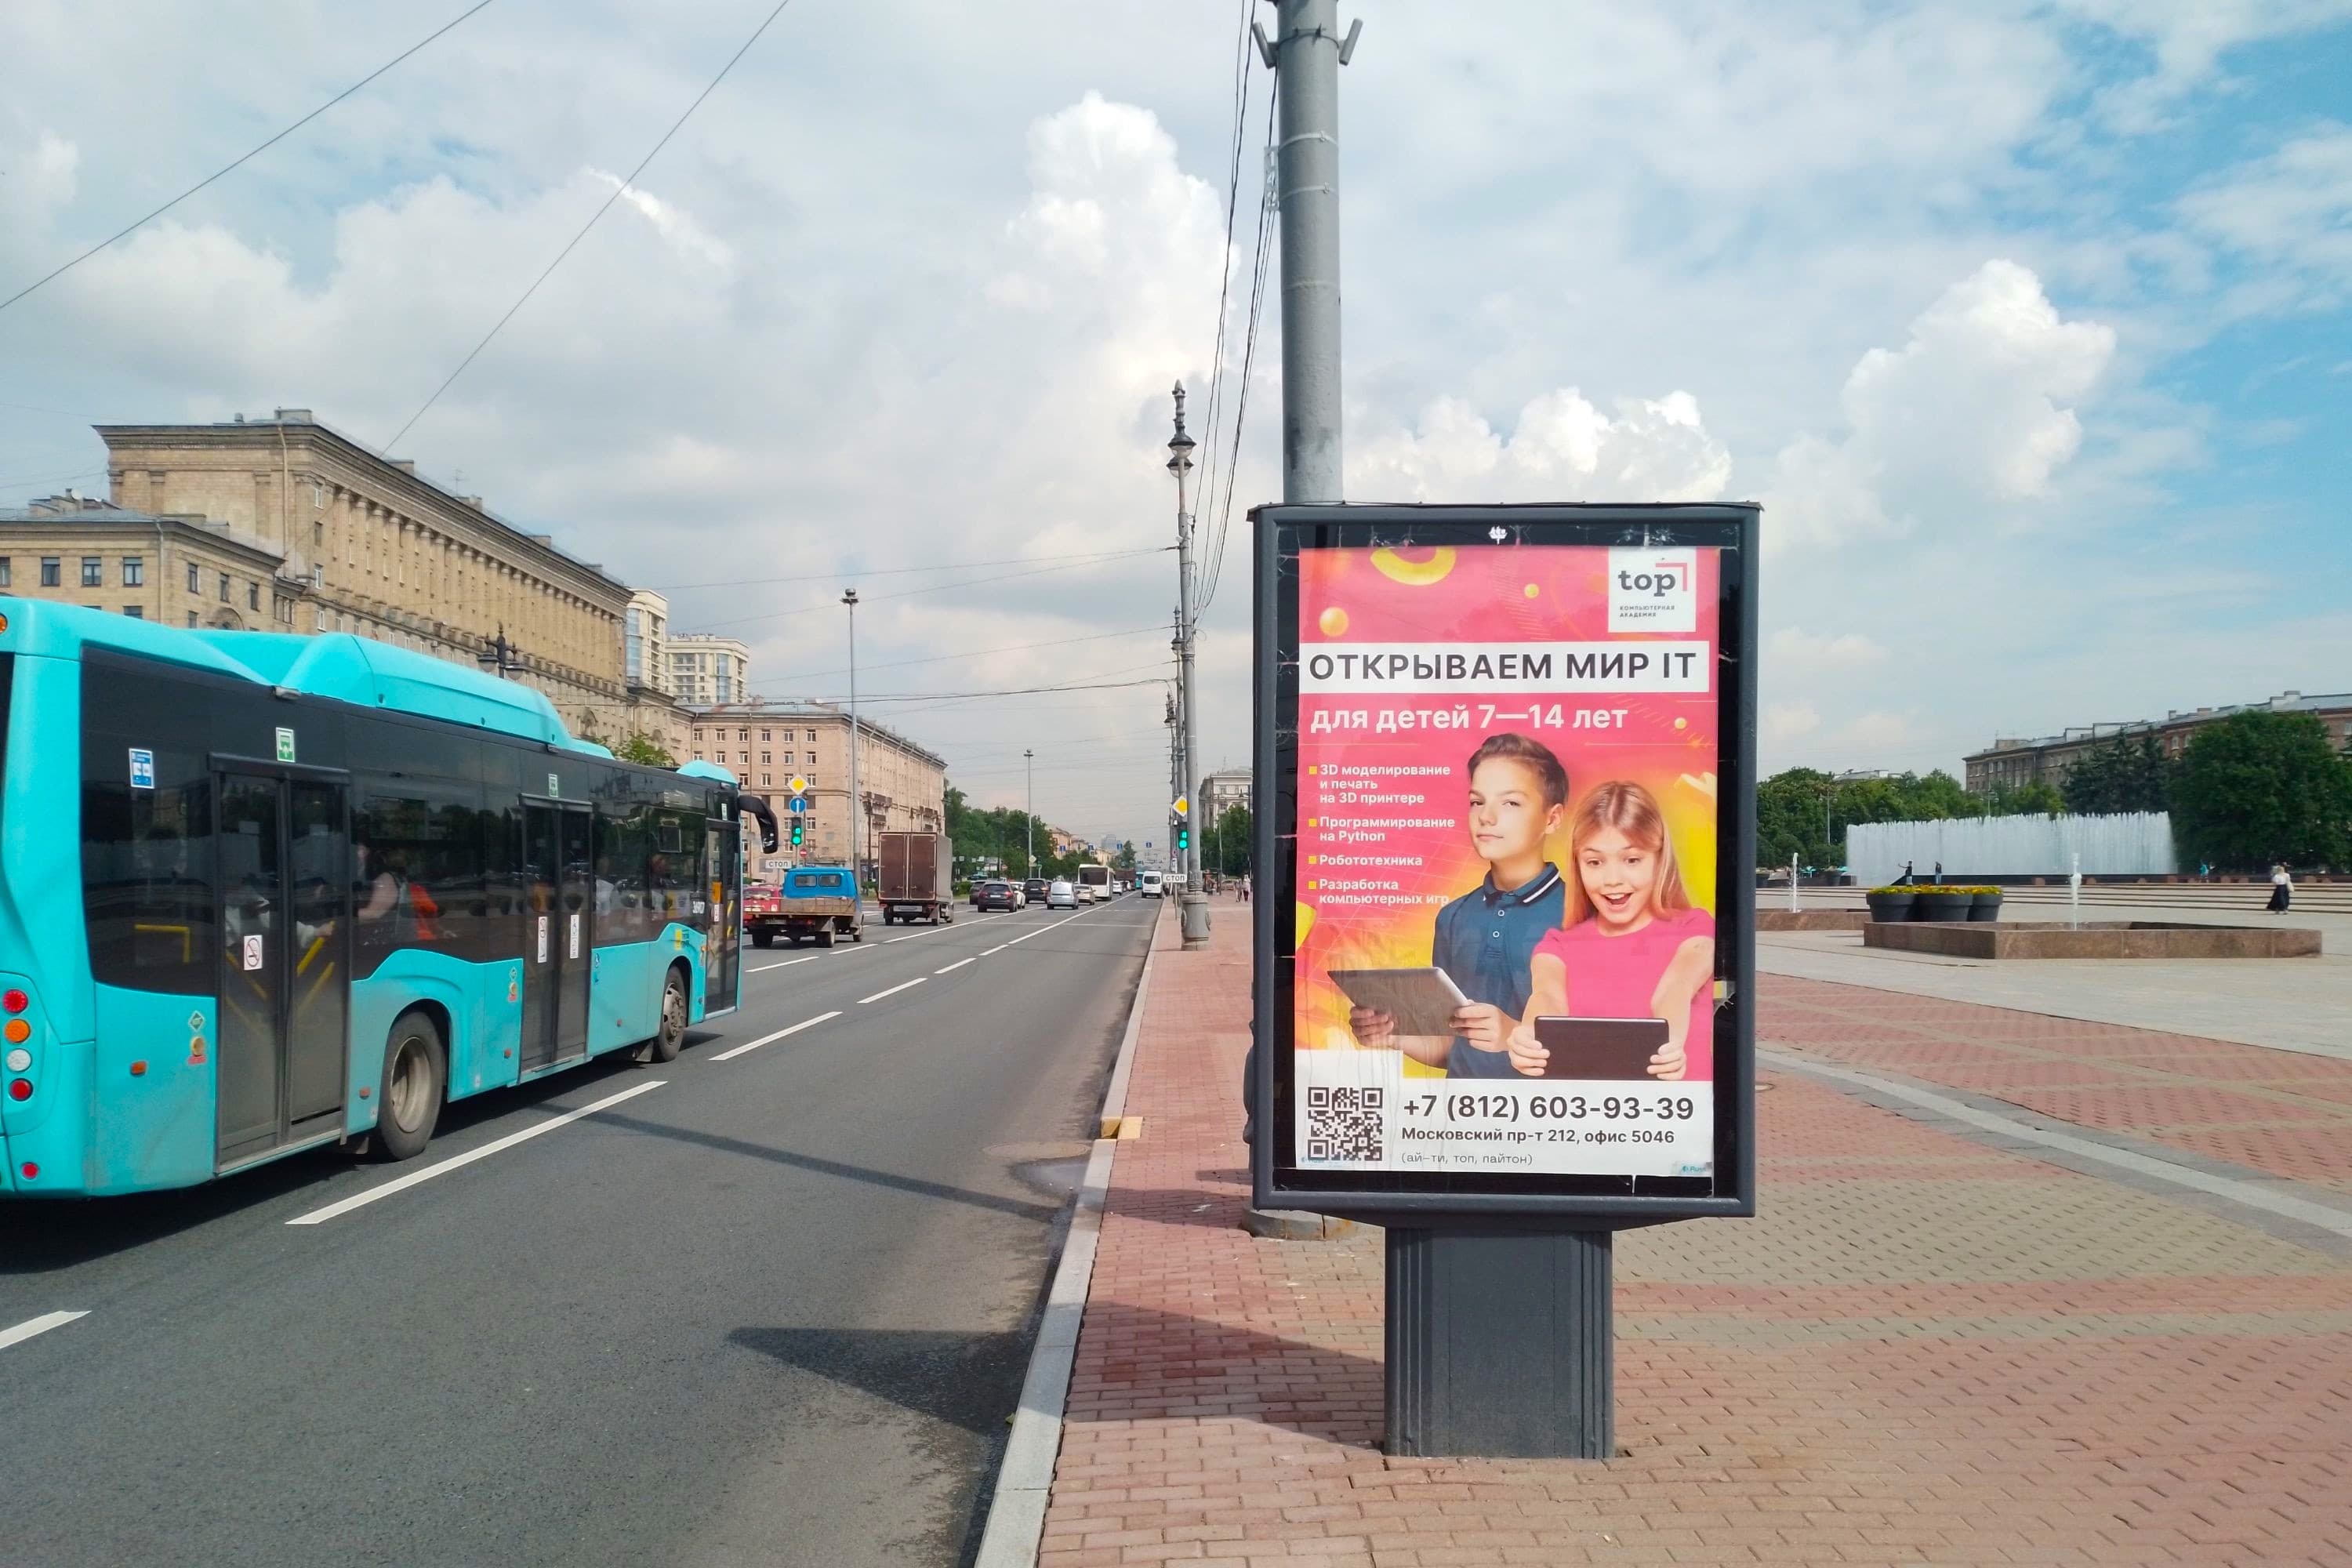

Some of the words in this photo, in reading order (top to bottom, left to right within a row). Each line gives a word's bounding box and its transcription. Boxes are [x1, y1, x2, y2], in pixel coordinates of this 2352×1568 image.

[1617, 570, 1676, 597] top
[1309, 654, 1552, 681] ОТКРЫВАЕМ
[1566, 653, 1650, 679] МИР
[1663, 652, 1697, 679] IT
[1310, 710, 1367, 734] для
[1375, 704, 1469, 734] детей
[1572, 709, 1628, 728] лет
[1320, 764, 1338, 775] 3D
[1341, 765, 1451, 777] моделирование
[1319, 780, 1328, 789] и
[1331, 780, 1378, 789] печать
[1319, 794, 1335, 804] на
[1338, 792, 1357, 804] 3D
[1360, 794, 1425, 806] принтере
[1319, 816, 1456, 829] Программирование
[1319, 832, 1335, 841] на
[1338, 830, 1385, 844] Python
[1319, 854, 1423, 866] Робототехника
[1319, 878, 1399, 891] Разработка
[1319, 895, 1422, 906] компьютерных
[1426, 895, 1450, 907] игр
[1403, 1094, 1438, 1117] +7
[1447, 1094, 1519, 1123] (812)
[1530, 1095, 1694, 1120] 603-93-39
[1402, 1127, 1503, 1141] Московский
[1507, 1131, 1544, 1144] пр-т
[1547, 1129, 1581, 1145] 212,
[1584, 1130, 1628, 1145] офис
[1632, 1131, 1675, 1144] 5046
[1453, 1155, 1478, 1165] топ,
[1482, 1153, 1534, 1166] пайтон)
